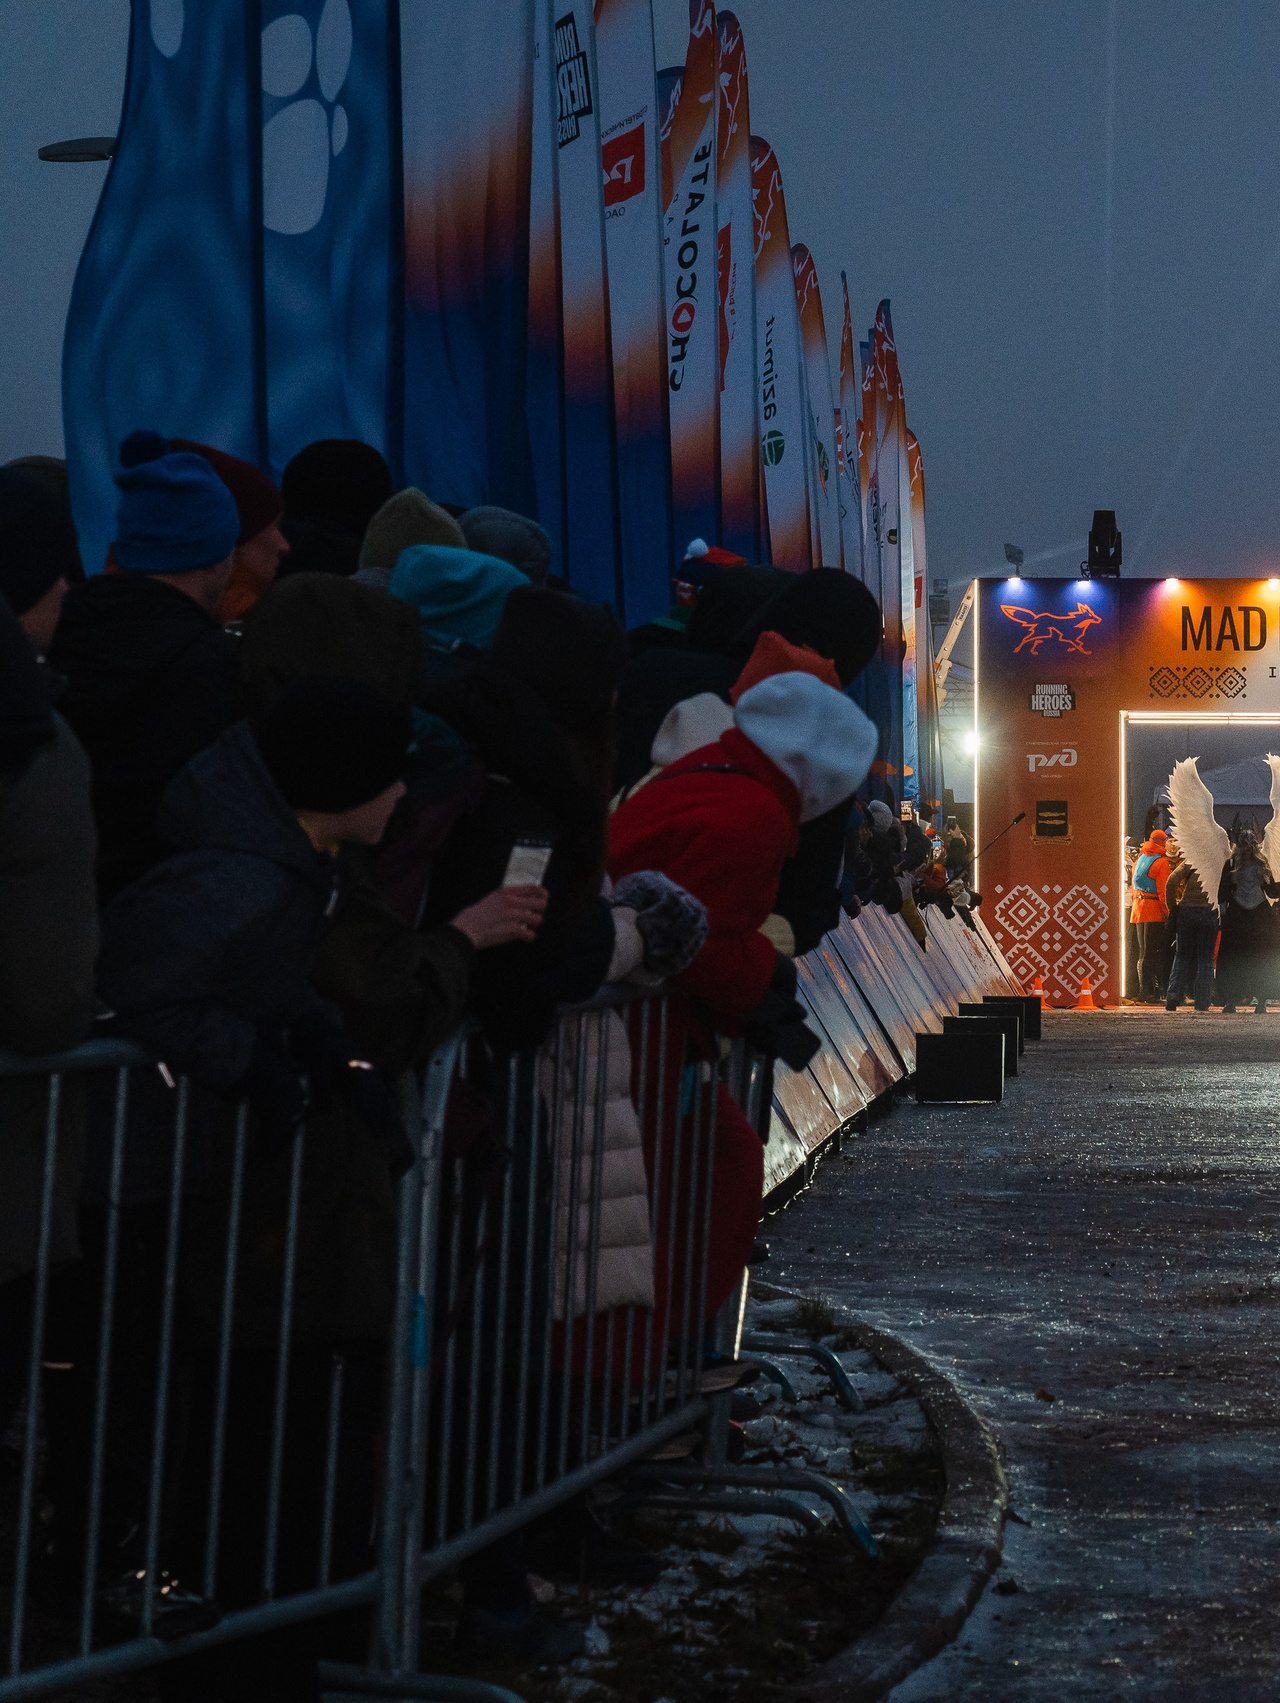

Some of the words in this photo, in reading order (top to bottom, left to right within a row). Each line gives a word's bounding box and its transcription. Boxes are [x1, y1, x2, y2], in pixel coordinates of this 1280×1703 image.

[1181, 606, 1267, 651] MAD
[1035, 684, 1068, 696] RUNNING
[1031, 695, 1072, 711] HEROES
